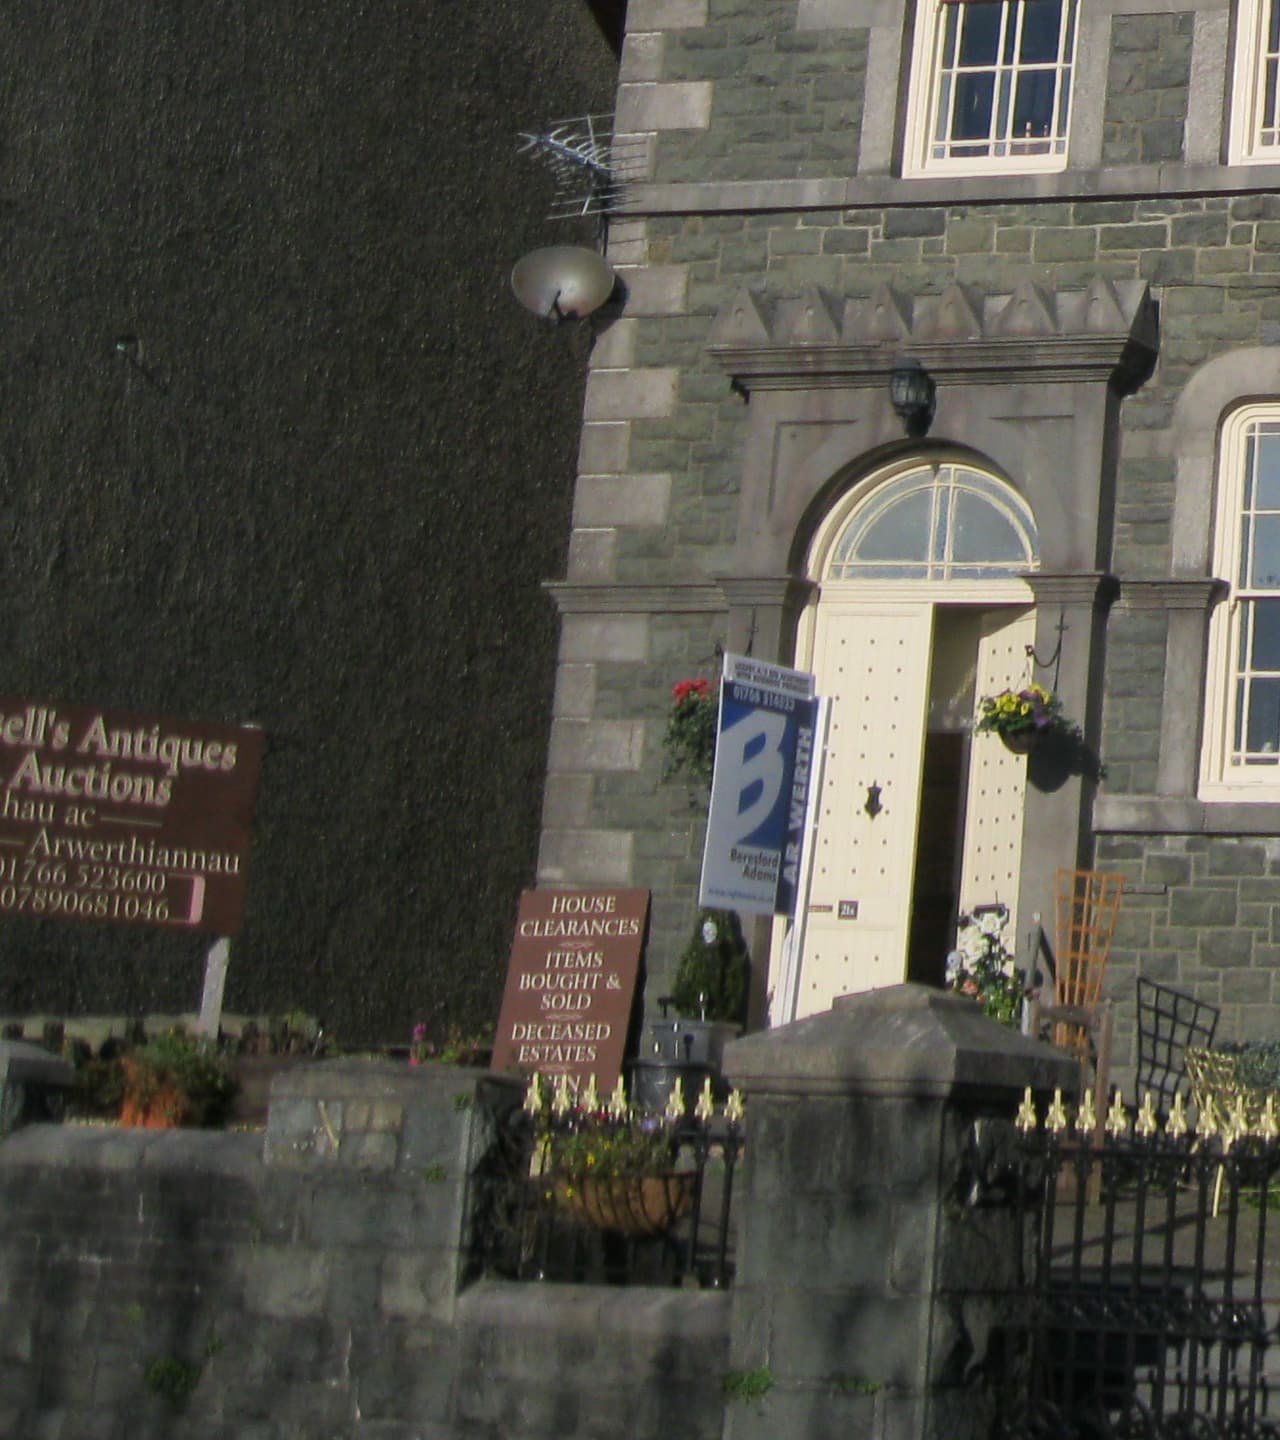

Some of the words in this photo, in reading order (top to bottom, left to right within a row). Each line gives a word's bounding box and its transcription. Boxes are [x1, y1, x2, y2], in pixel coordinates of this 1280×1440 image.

[79, 715, 238, 776] Antiques
[10, 751, 172, 806] Auctions
[65, 806, 96, 827] ac
[30, 828, 240, 874] Arwerthiannau
[75, 863, 166, 893] 523600
[1, 885, 170, 921] 07890681046
[551, 896, 616, 914] HOUSE
[520, 919, 641, 937] CLEARANCES
[545, 951, 604, 969] ITEMS
[519, 973, 603, 990] BOUGHT
[606, 973, 622, 990] &
[539, 993, 592, 1011] SOLD
[511, 1023, 611, 1041] DECEASED
[518, 1045, 598, 1063] ESTATES
